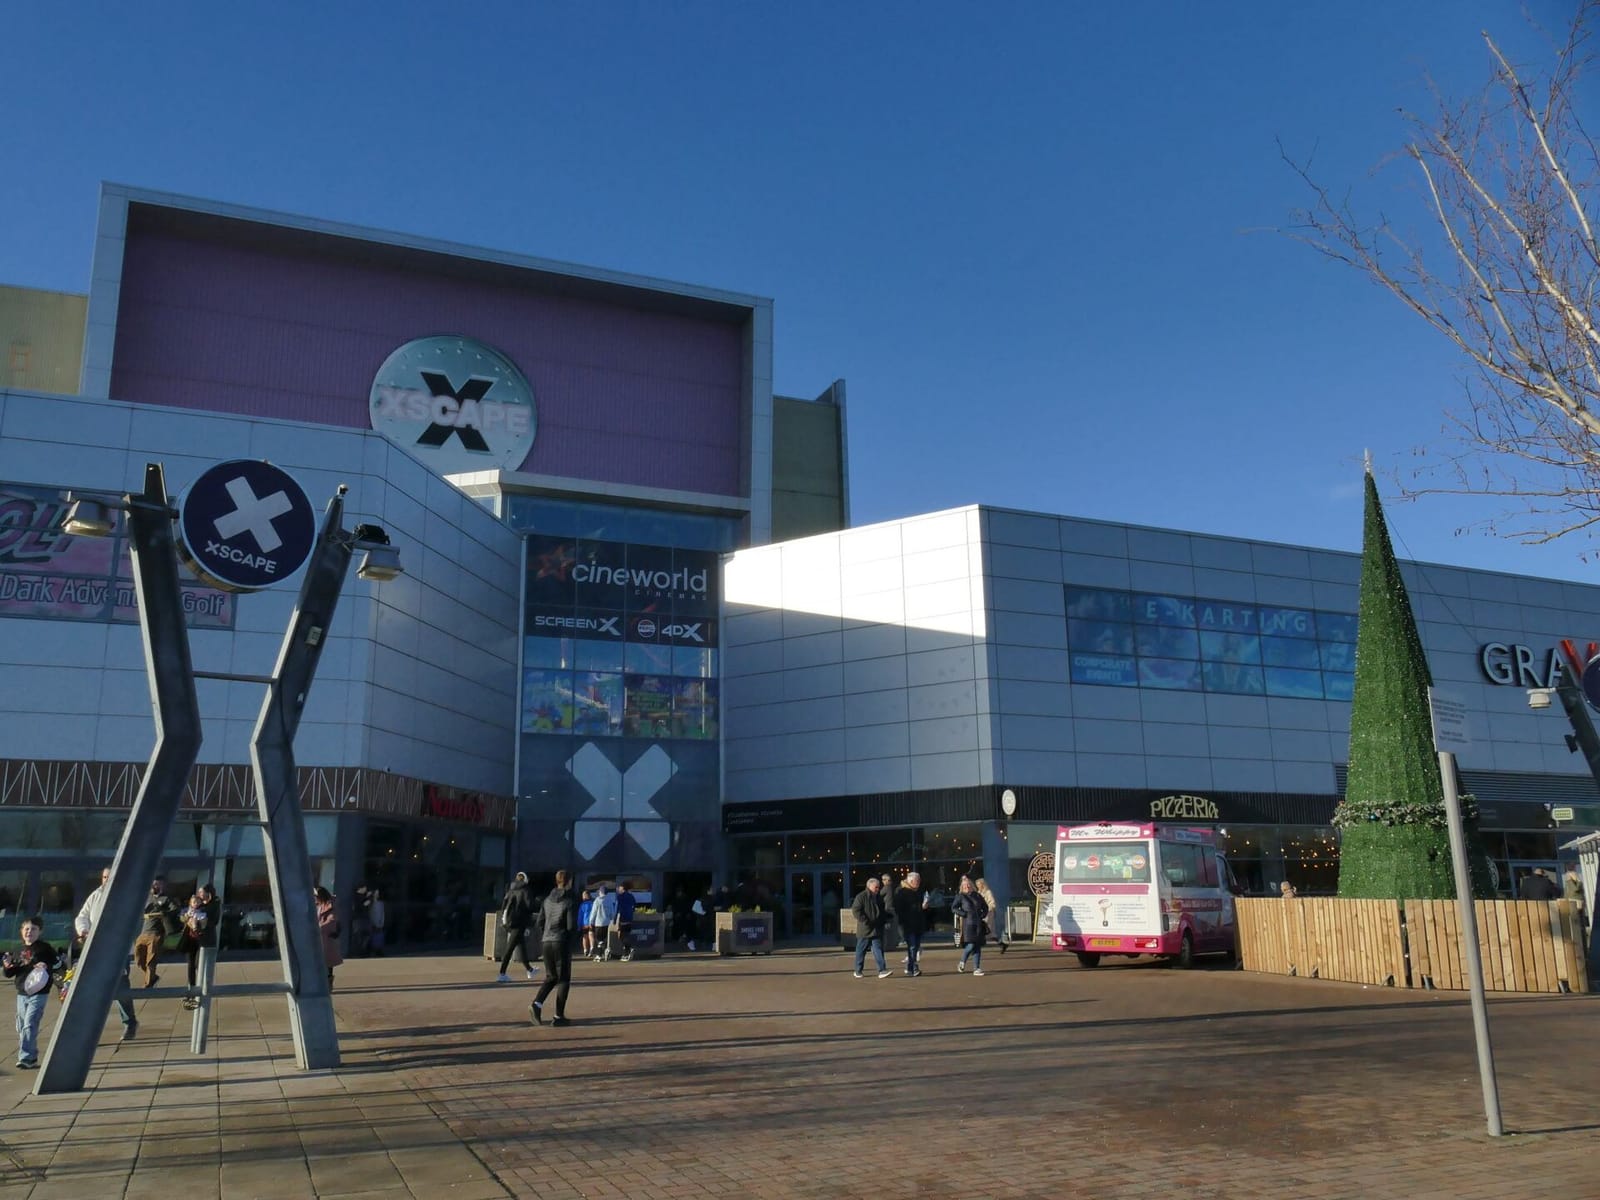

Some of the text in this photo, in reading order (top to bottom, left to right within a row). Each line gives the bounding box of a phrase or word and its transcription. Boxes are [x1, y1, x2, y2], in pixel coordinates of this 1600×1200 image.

[378, 386, 532, 433] XSCAPE
[205, 540, 277, 574] XSCAPE
[572, 561, 707, 592] cineworld
[2, 575, 54, 601] Dark
[182, 591, 225, 616] Golf
[634, 589, 707, 600] CINEMAS
[661, 622, 704, 642] 4DX
[1150, 795, 1219, 818] PIZZERIA
